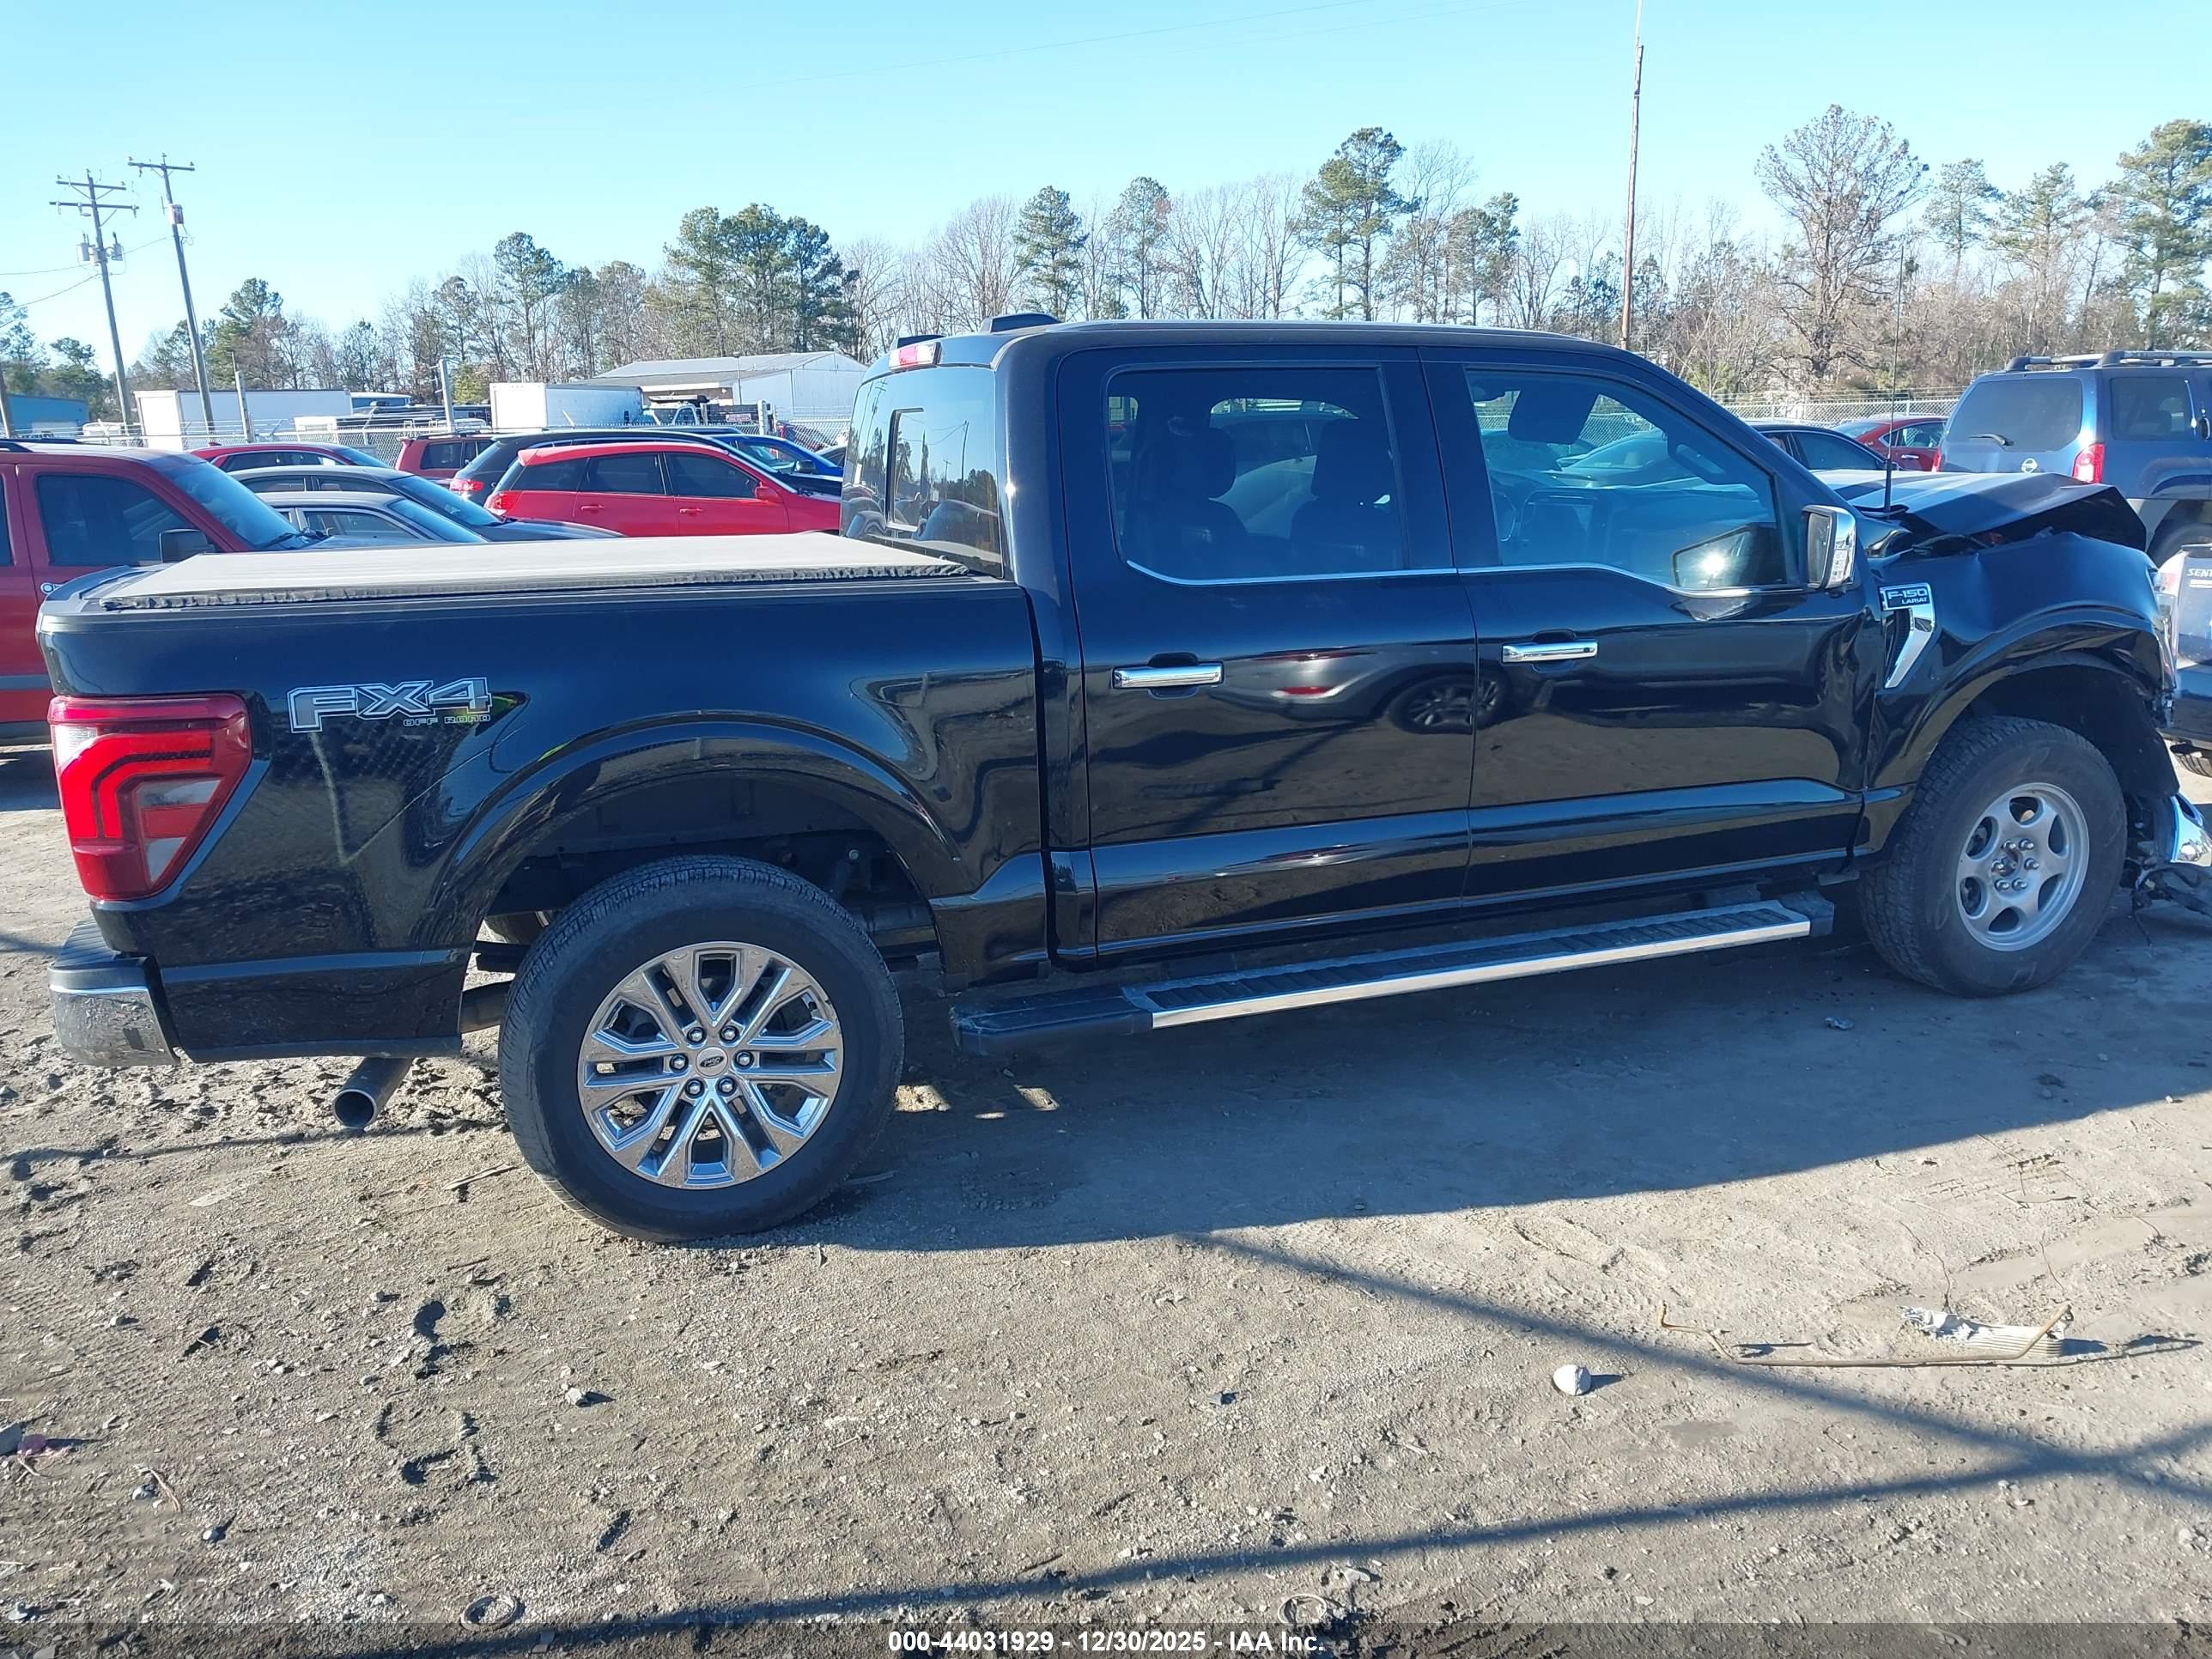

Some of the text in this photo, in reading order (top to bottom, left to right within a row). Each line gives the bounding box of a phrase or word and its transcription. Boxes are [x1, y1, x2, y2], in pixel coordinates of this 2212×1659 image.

[1887, 588, 1927, 599] F-150
[287, 677, 492, 733] FX4
[403, 714, 491, 726] OFF ROAD
